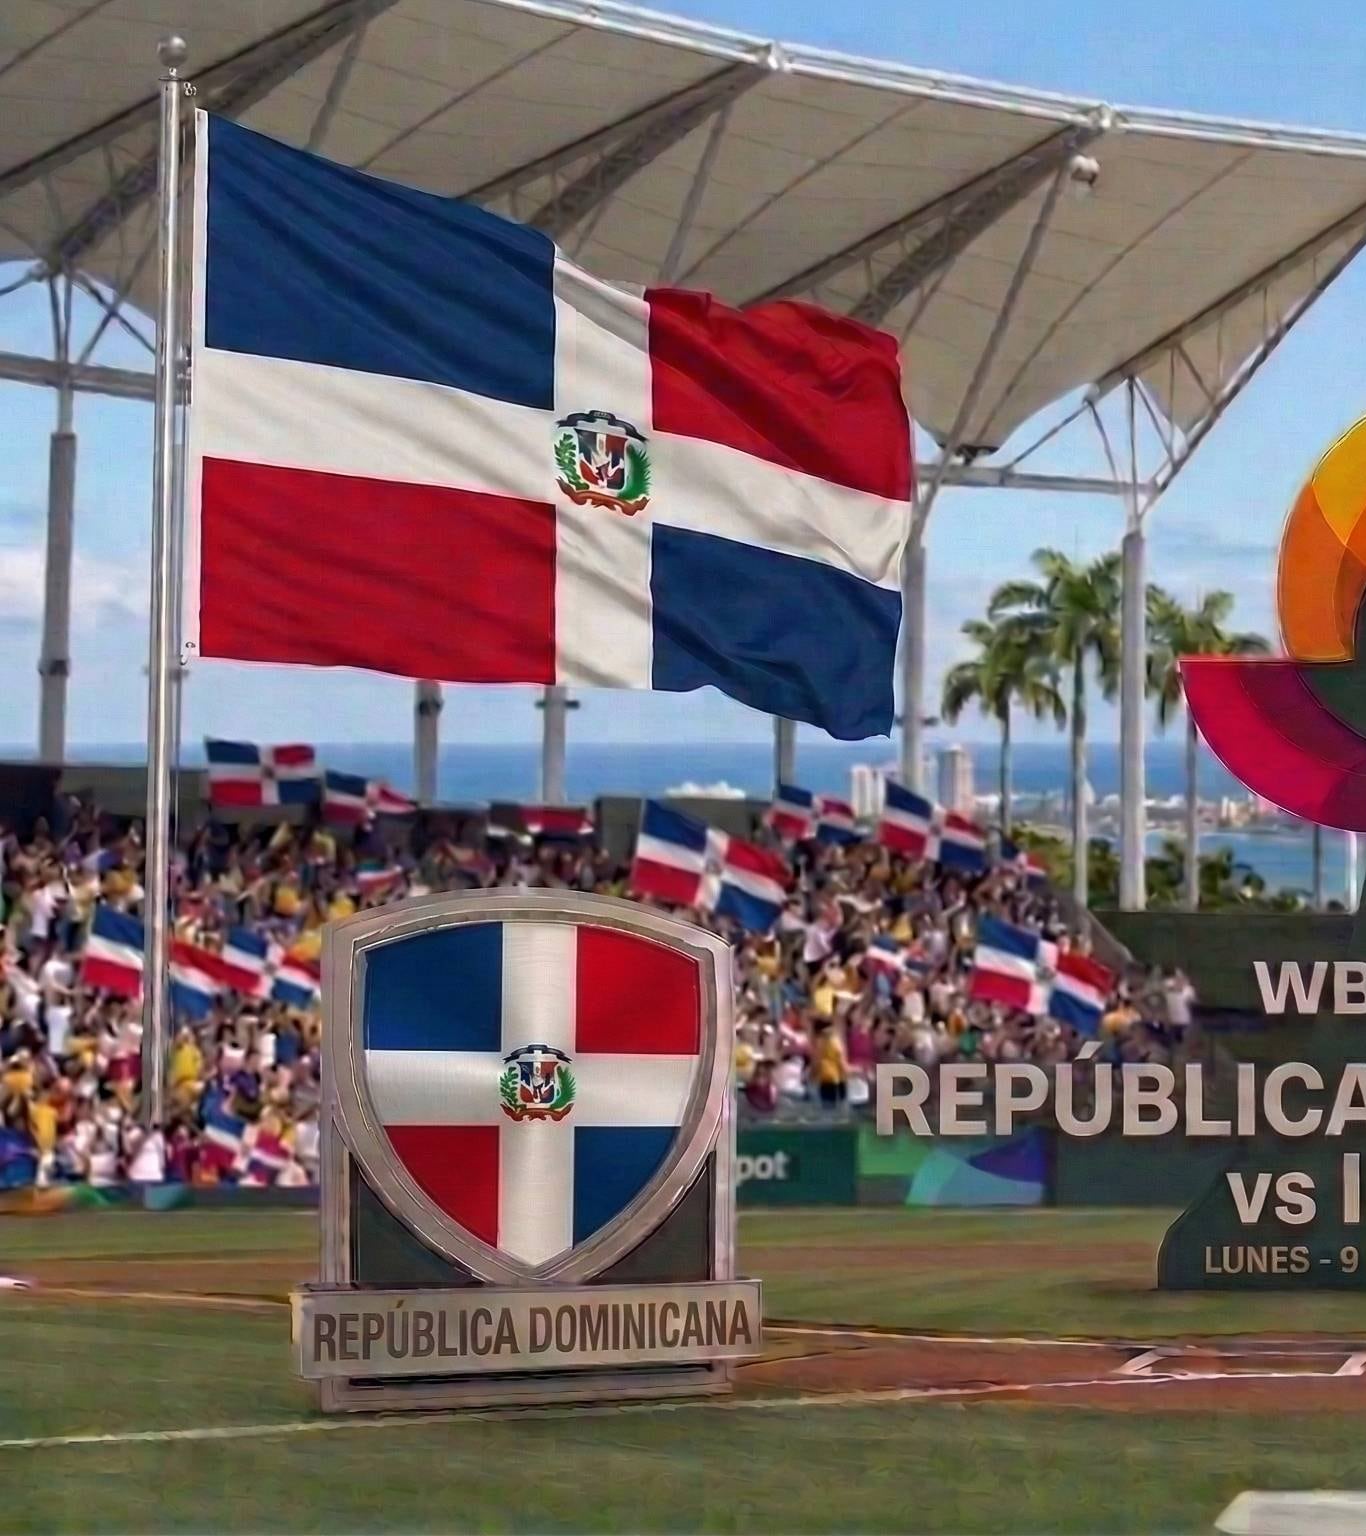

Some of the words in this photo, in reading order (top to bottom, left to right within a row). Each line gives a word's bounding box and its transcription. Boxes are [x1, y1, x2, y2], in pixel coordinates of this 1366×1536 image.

[1226, 1172, 1317, 1224] vs
[1204, 1246, 1310, 1275] LUNES
[1341, 1246, 1360, 1275] 9
[313, 1300, 520, 1362] REPÚBLICA
[528, 1300, 752, 1353] DOMINICANA
